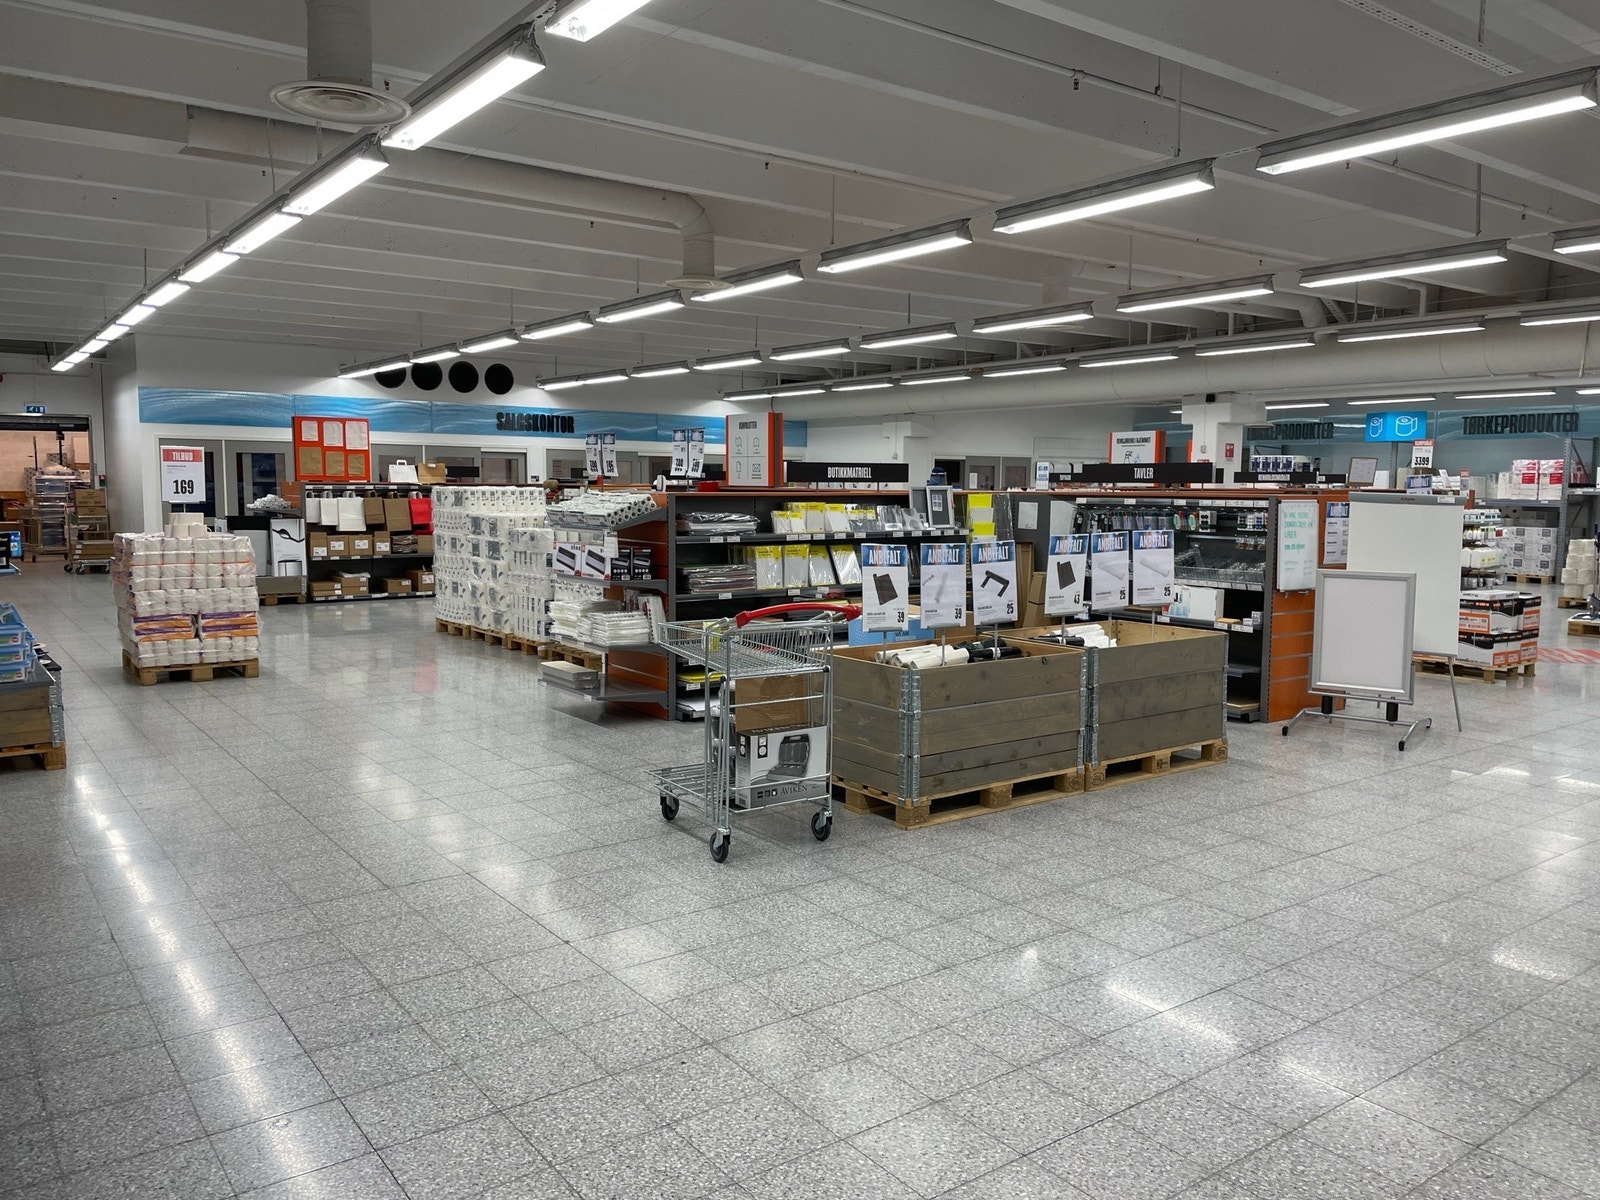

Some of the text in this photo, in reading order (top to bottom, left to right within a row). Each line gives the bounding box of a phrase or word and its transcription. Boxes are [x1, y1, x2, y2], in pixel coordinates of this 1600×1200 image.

[496, 412, 575, 434] SALGSKONTOR
[1462, 412, 1579, 435] TØRKEPRODUKTER
[172, 452, 193, 461] TILBUD
[1415, 457, 1429, 466] 3399
[828, 467, 871, 478] BUTIKKMATRIELL
[1134, 467, 1153, 479] TAVLER
[173, 479, 194, 495] 169
[1055, 540, 1083, 553] ANBEFALT
[1097, 537, 1124, 551] ANBEFALT
[1140, 535, 1168, 548] ANBEFALT
[868, 550, 901, 564] ANBEFALT
[927, 549, 960, 563] ANBEFALT
[978, 546, 1009, 562] ANBEFALT
[1120, 590, 1126, 600] 25
[1164, 586, 1171, 596] 25
[1073, 594, 1080, 604] 43
[955, 608, 962, 619] 39
[1007, 603, 1014, 614] 25
[897, 611, 905, 623] 39
